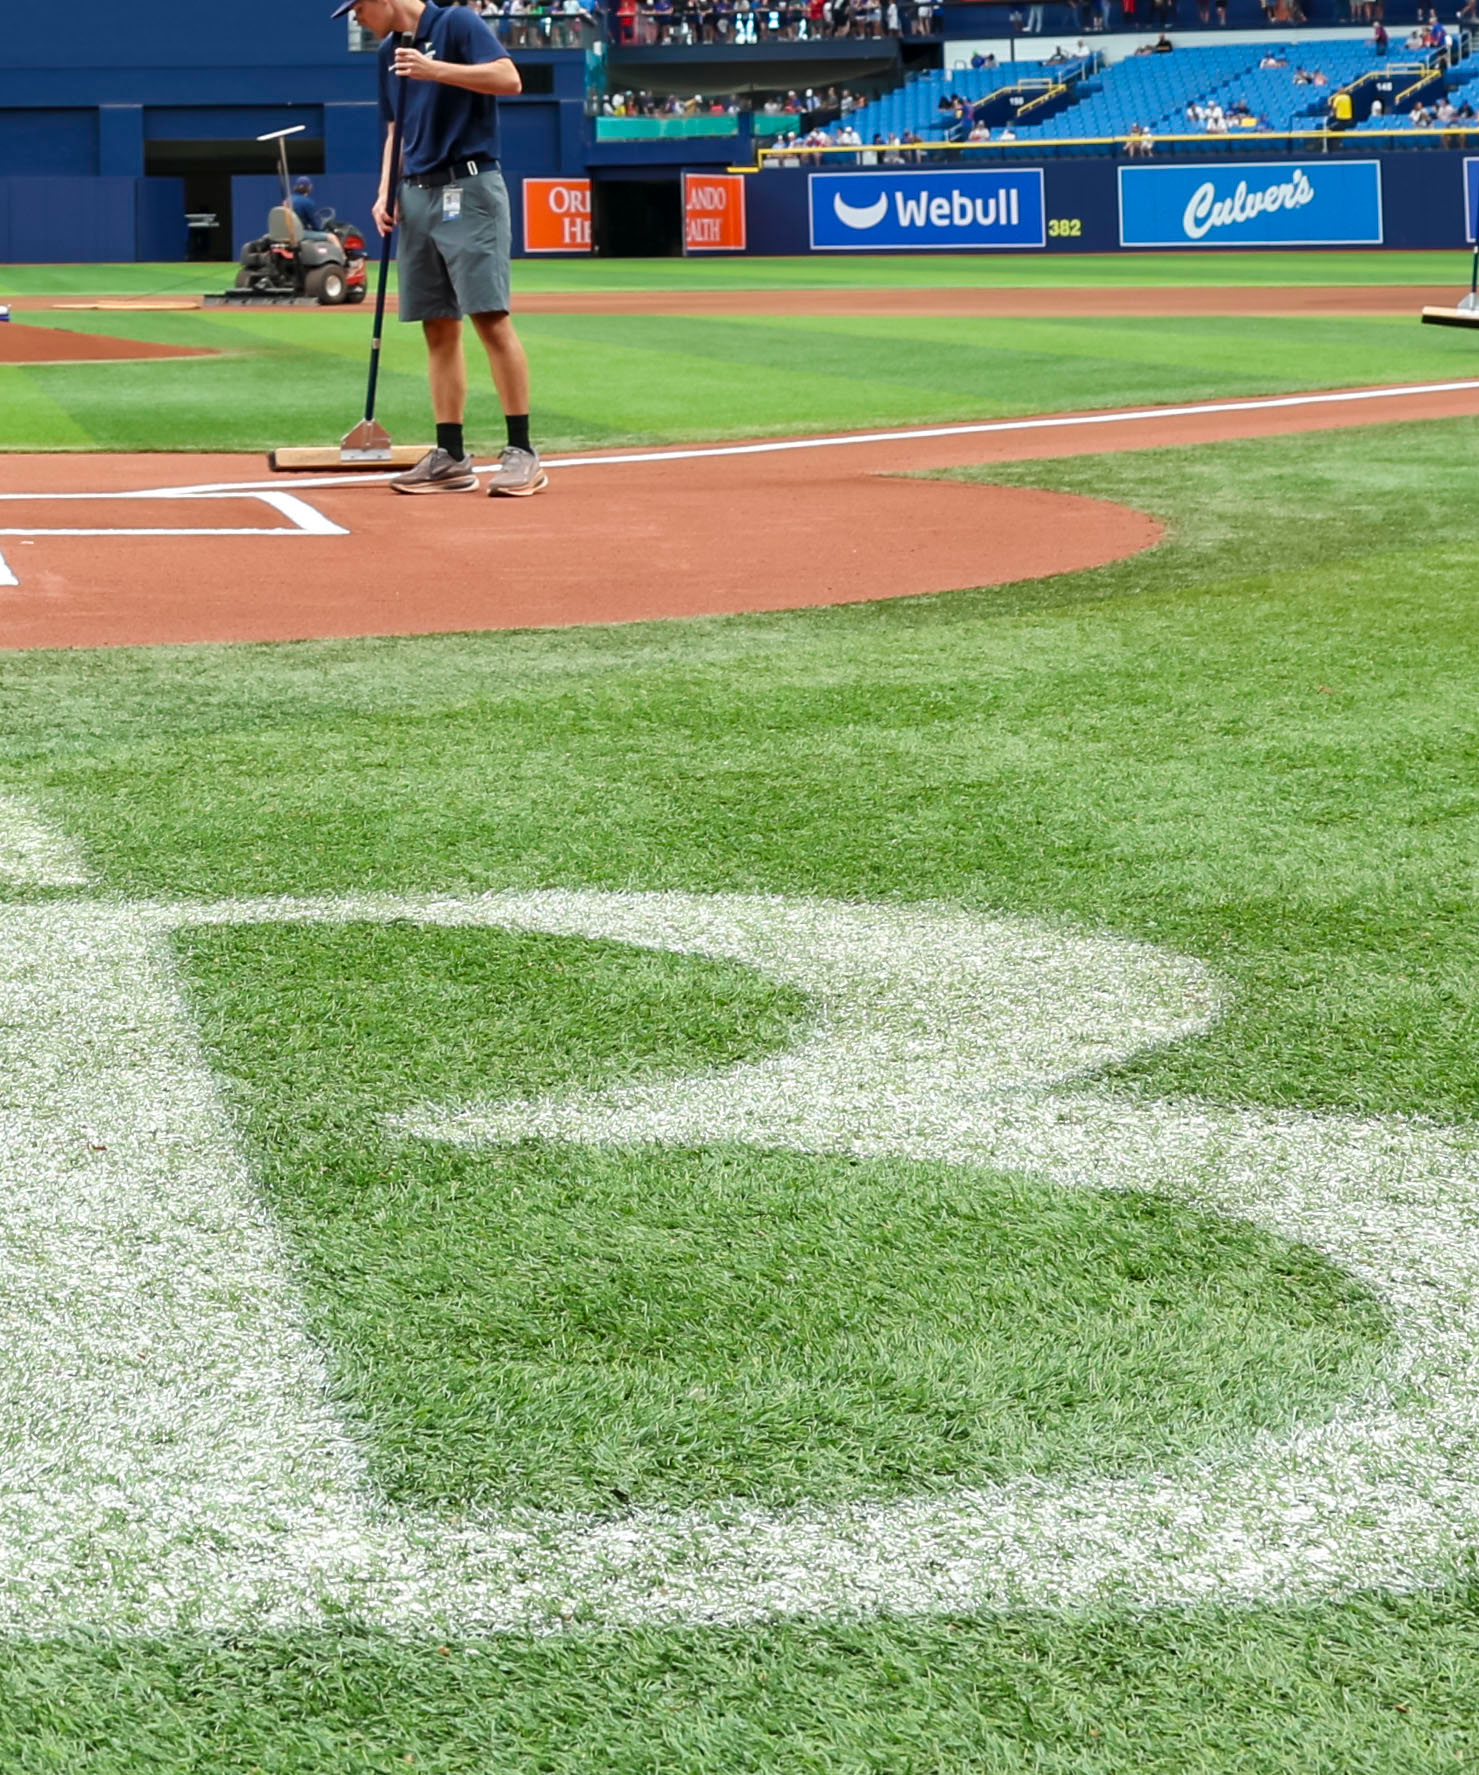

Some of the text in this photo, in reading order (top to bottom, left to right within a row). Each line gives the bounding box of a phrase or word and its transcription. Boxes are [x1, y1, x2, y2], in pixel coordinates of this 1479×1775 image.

[895, 188, 1020, 228] Webull
[1183, 168, 1316, 240] Culver's
[1048, 218, 1082, 237] 382
